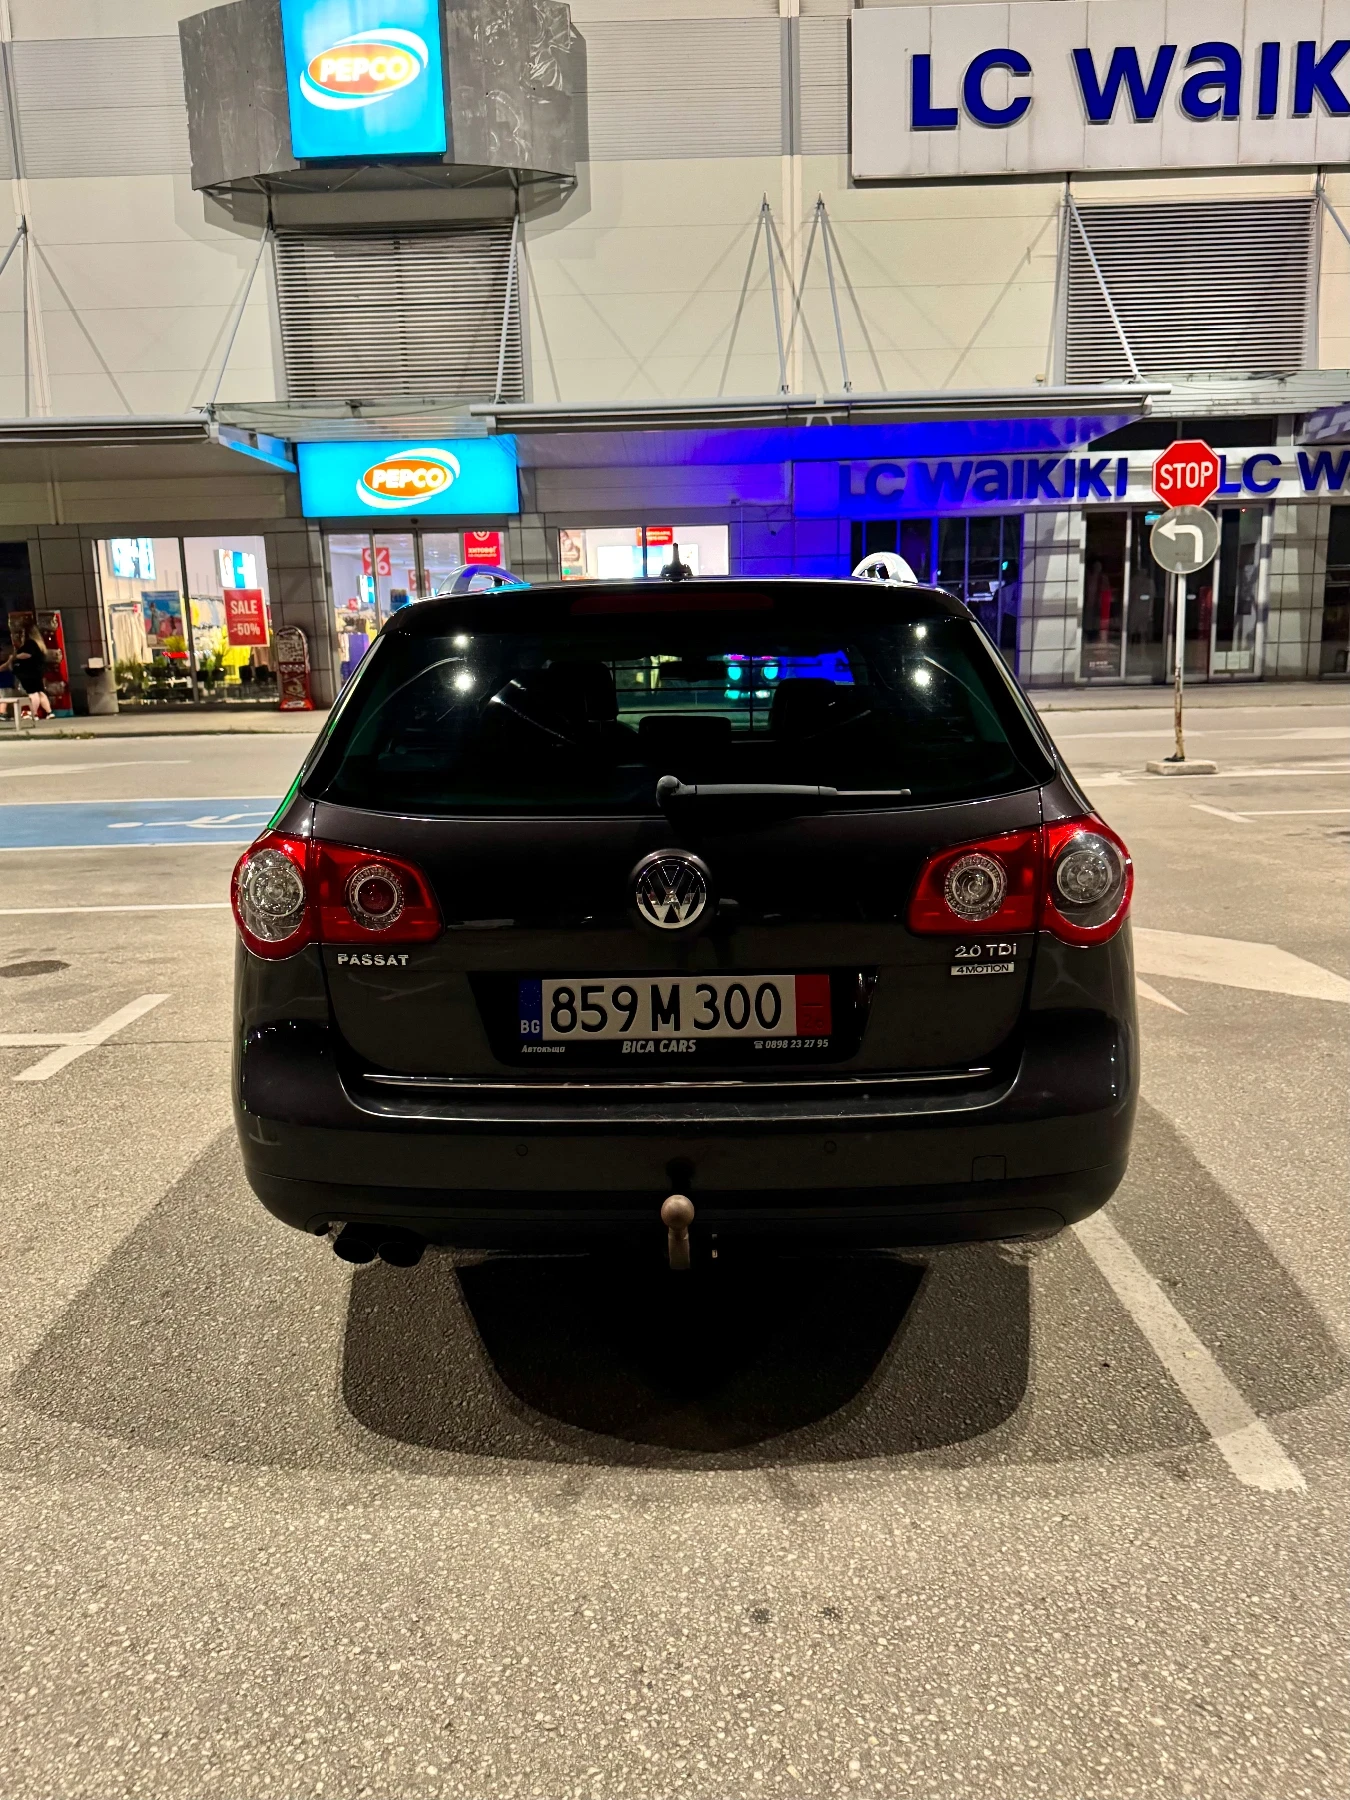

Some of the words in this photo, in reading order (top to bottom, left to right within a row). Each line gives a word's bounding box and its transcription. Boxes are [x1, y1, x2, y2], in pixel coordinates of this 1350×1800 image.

[318, 57, 406, 82] PEPCO
[908, 47, 1033, 131] LC
[372, 467, 447, 488] PEPCO
[1160, 461, 1213, 490] STOP
[1218, 453, 1282, 494] LC
[839, 463, 906, 502] LC
[230, 600, 258, 614] SALE
[230, 623, 260, 636] -50%
[337, 953, 409, 967] PASSAT
[956, 964, 1009, 974] 4MOTION
[551, 986, 638, 1033] 859
[651, 984, 681, 1032] M
[694, 982, 782, 1031] 300
[520, 1020, 540, 1034] BG
[521, 1044, 566, 1053] Автокъща
[622, 1041, 655, 1053] BICA
[659, 1040, 696, 1052] CARS
[765, 1040, 788, 1049] 0898
[790, 1040, 802, 1048] 23
[804, 1040, 815, 1048] 27
[817, 1039, 829, 1048] 95
